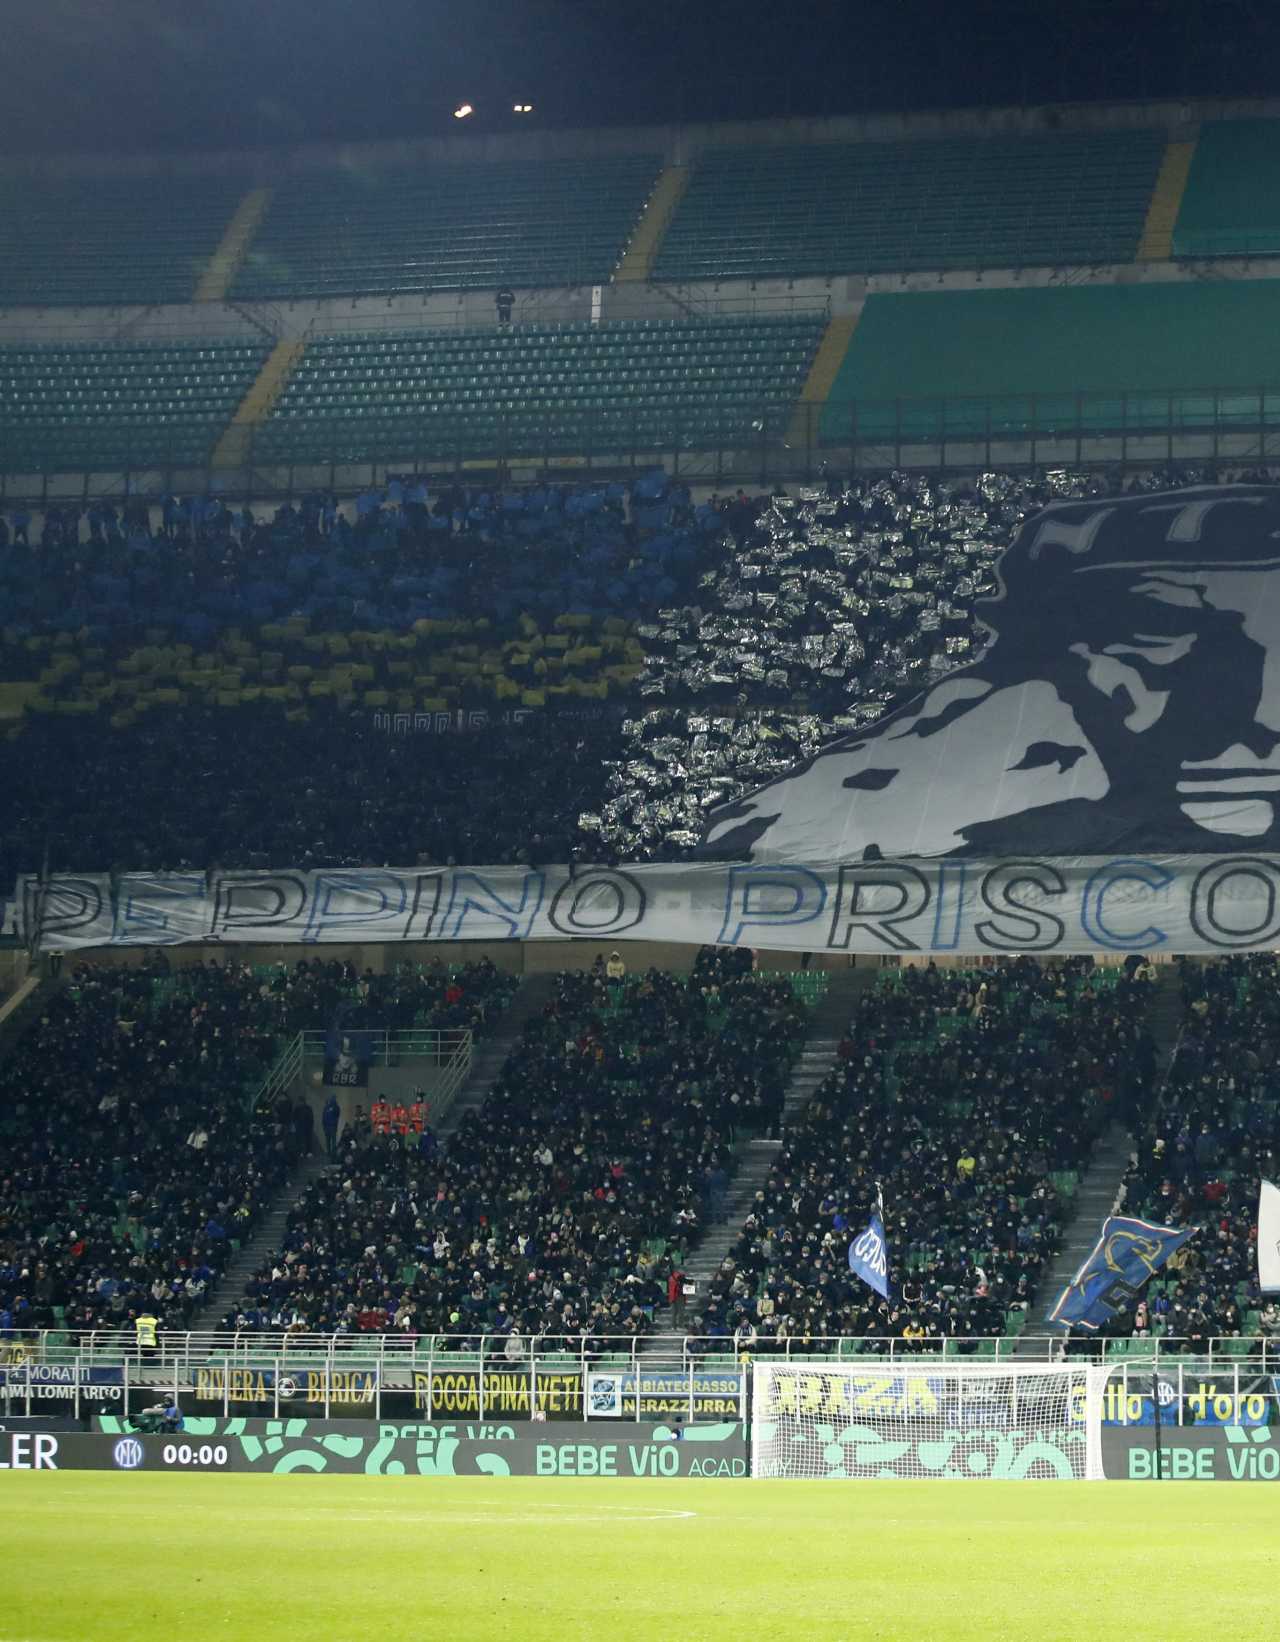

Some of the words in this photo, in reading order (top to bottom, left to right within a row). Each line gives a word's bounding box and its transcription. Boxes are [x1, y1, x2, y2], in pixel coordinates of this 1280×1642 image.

[20, 867, 647, 943] PEPPINO
[30, 1366, 90, 1381] MORATTI
[196, 1368, 267, 1402] RIVIERA
[623, 1398, 737, 1413] NERAZZURRA
[1072, 1384, 1142, 1421] Gllo
[163, 1444, 228, 1465] 00:00
[536, 1445, 617, 1476] BEBE
[1128, 1447, 1215, 1480] BEBE
